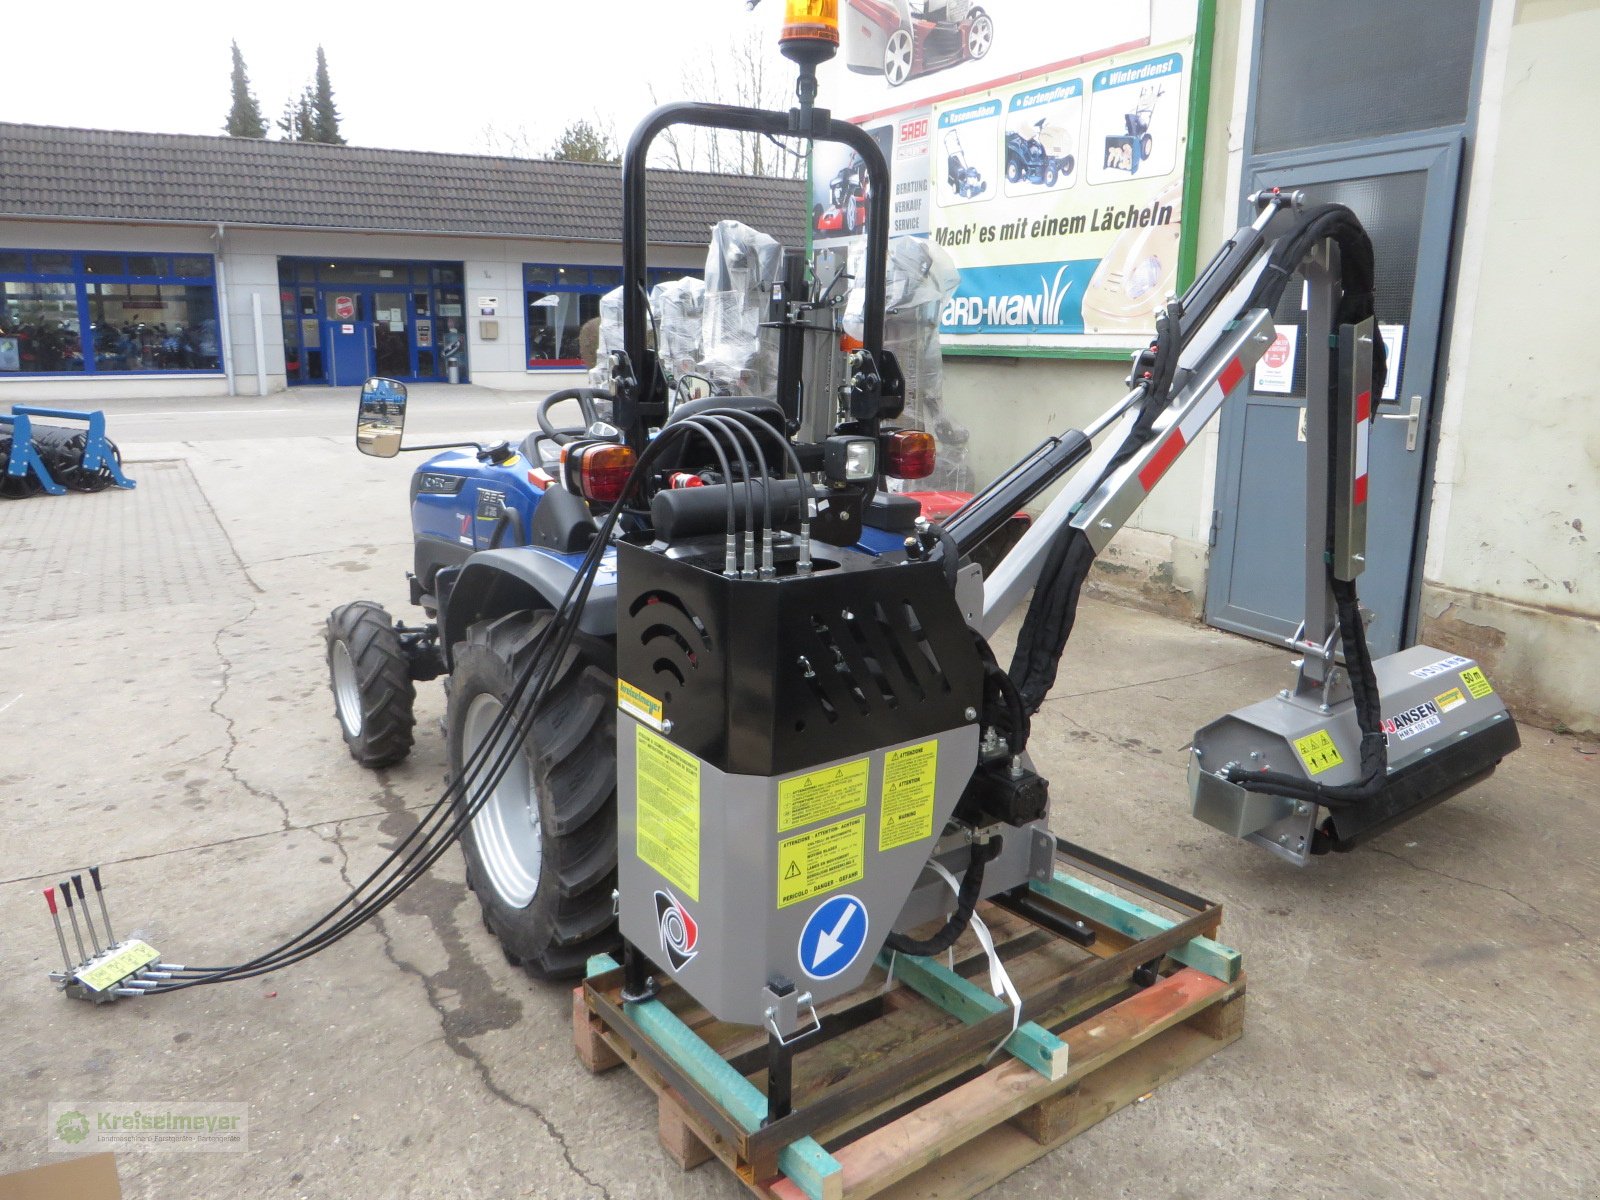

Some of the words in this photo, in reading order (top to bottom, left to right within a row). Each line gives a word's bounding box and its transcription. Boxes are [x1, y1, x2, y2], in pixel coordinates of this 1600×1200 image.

[1109, 58, 1174, 85] Winterdienst
[1023, 84, 1076, 107] Gartenpflege
[901, 119, 928, 141] SABO
[896, 180, 928, 195] BERATUNG
[895, 199, 922, 213] VERKAUF
[895, 217, 920, 231] SERVICE
[979, 226, 996, 243] es
[1000, 218, 1028, 241] mit
[1031, 215, 1085, 238] einem
[1091, 202, 1173, 231] Lächeln
[1463, 672, 1475, 684] 50
[1386, 701, 1438, 733] JANSEN
[899, 747, 924, 758] ATTENZIONE
[899, 777, 920, 787] ATTENTION
[783, 836, 810, 848] ATTENZIONE
[840, 819, 861, 829] ACHTUNG
[782, 889, 809, 903] PERICOLO
[813, 879, 834, 892] DANGER
[838, 870, 858, 882] GEFAHR
